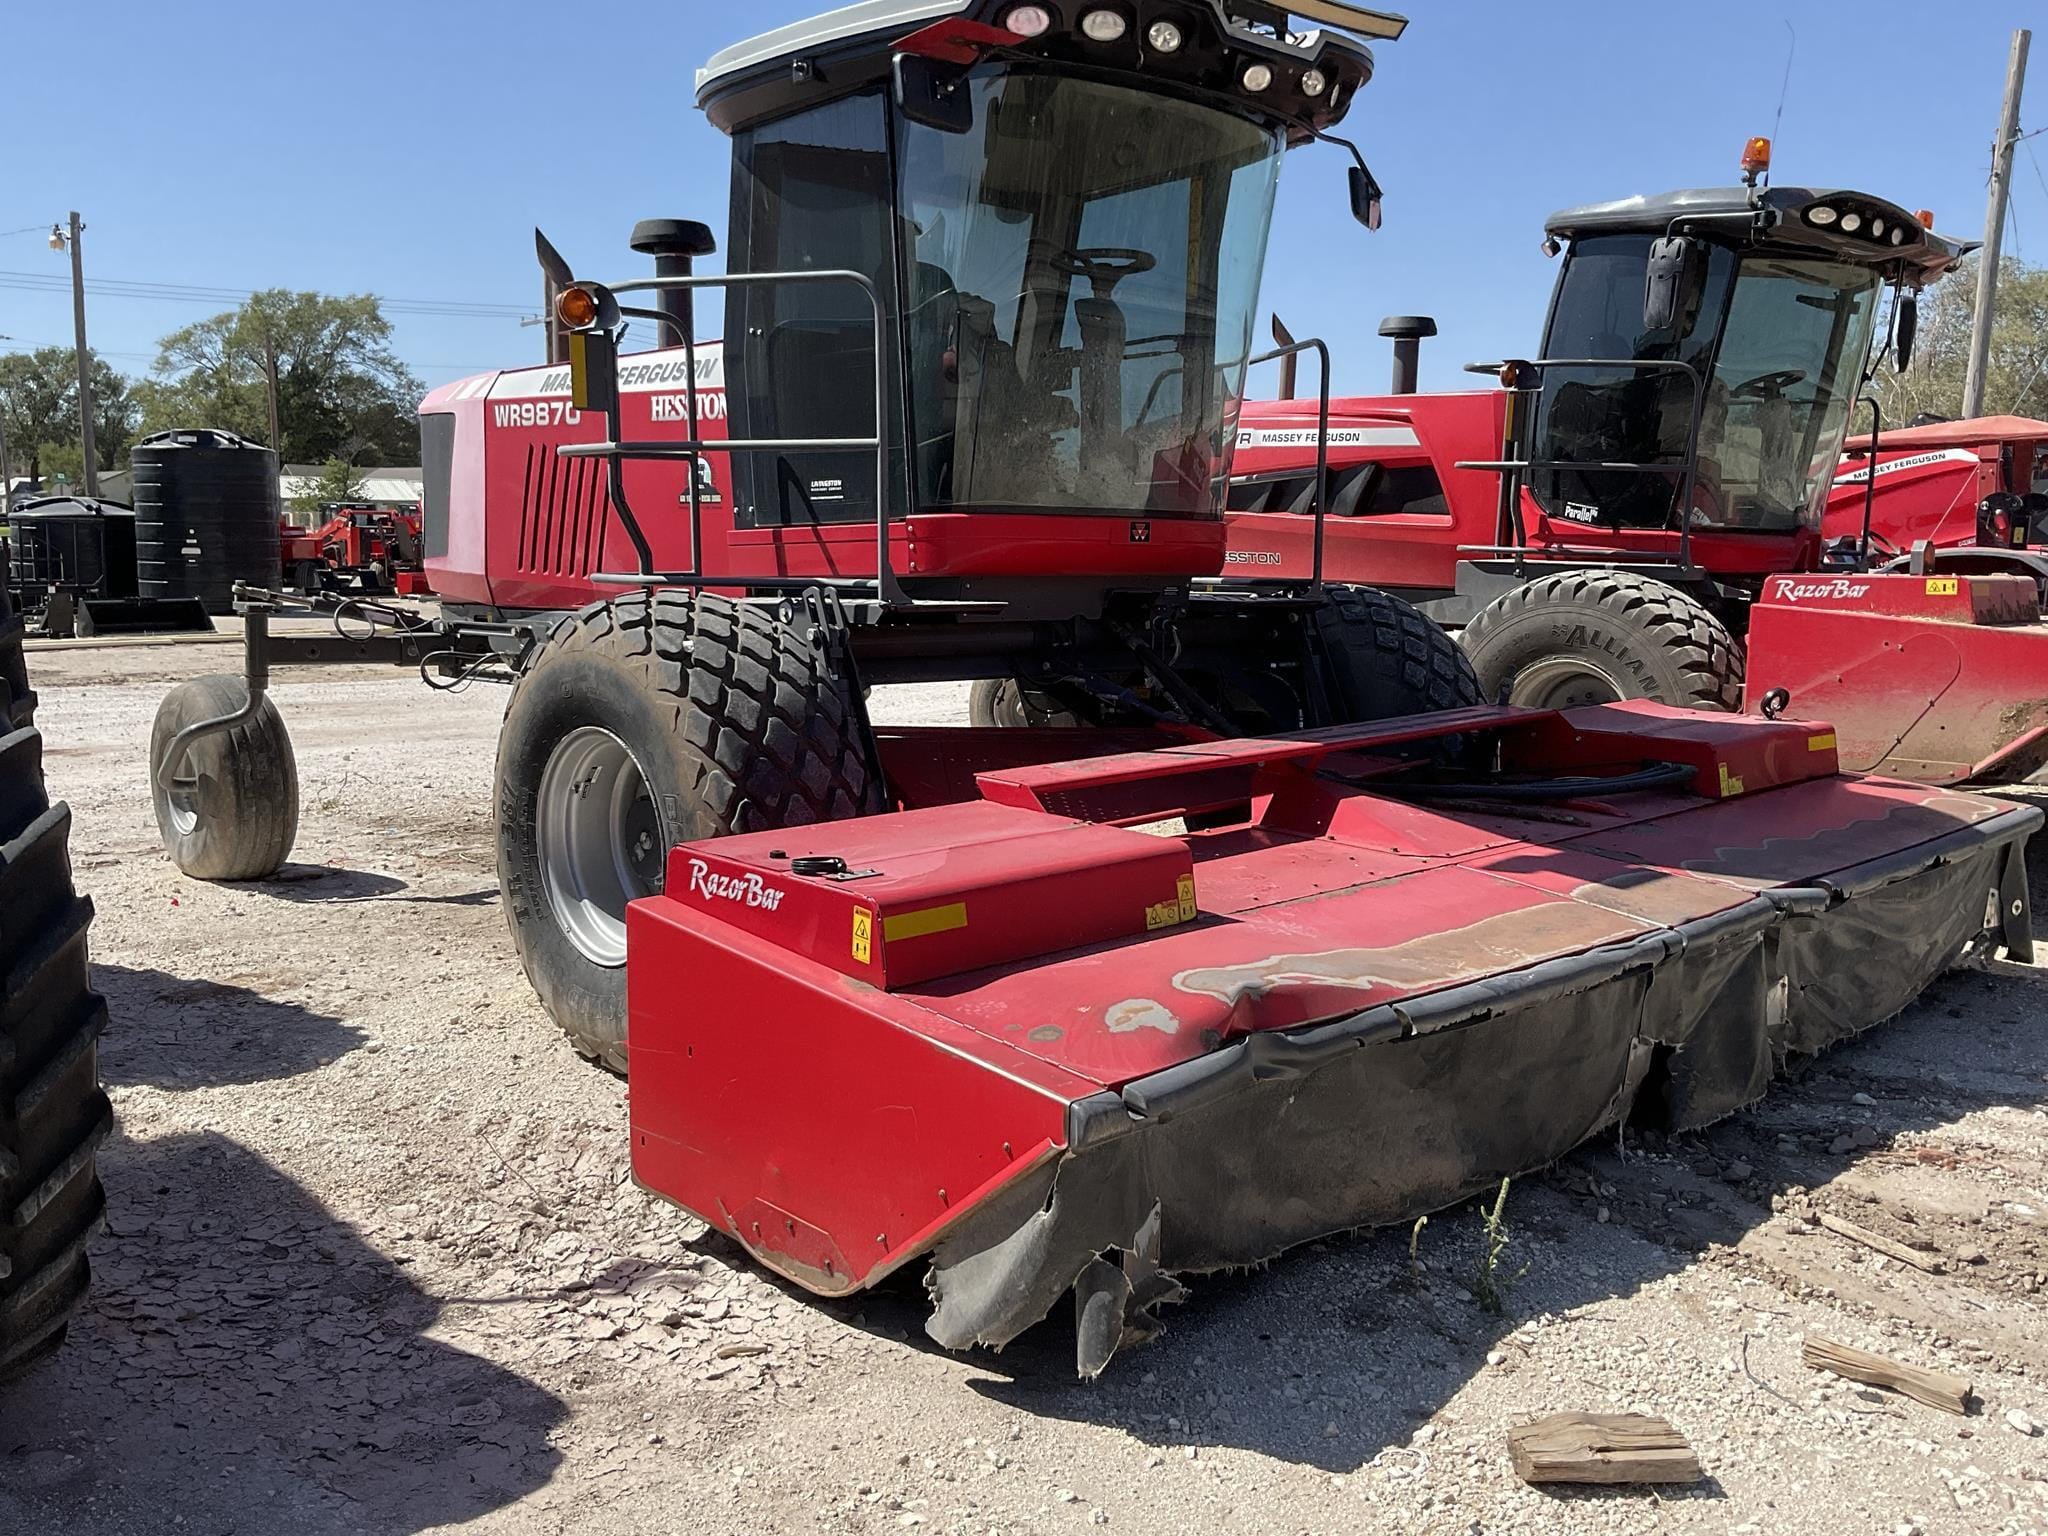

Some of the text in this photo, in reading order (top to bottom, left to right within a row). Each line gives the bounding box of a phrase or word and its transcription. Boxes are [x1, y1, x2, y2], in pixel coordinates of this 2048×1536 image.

[494, 401, 581, 428] WR9870
[1262, 432, 1361, 443] MASSEY FEGUSON
[1853, 453, 1946, 480] MASEY FERGUSON
[1775, 579, 1870, 602] RazorBar
[688, 858, 785, 912] RazorBar
